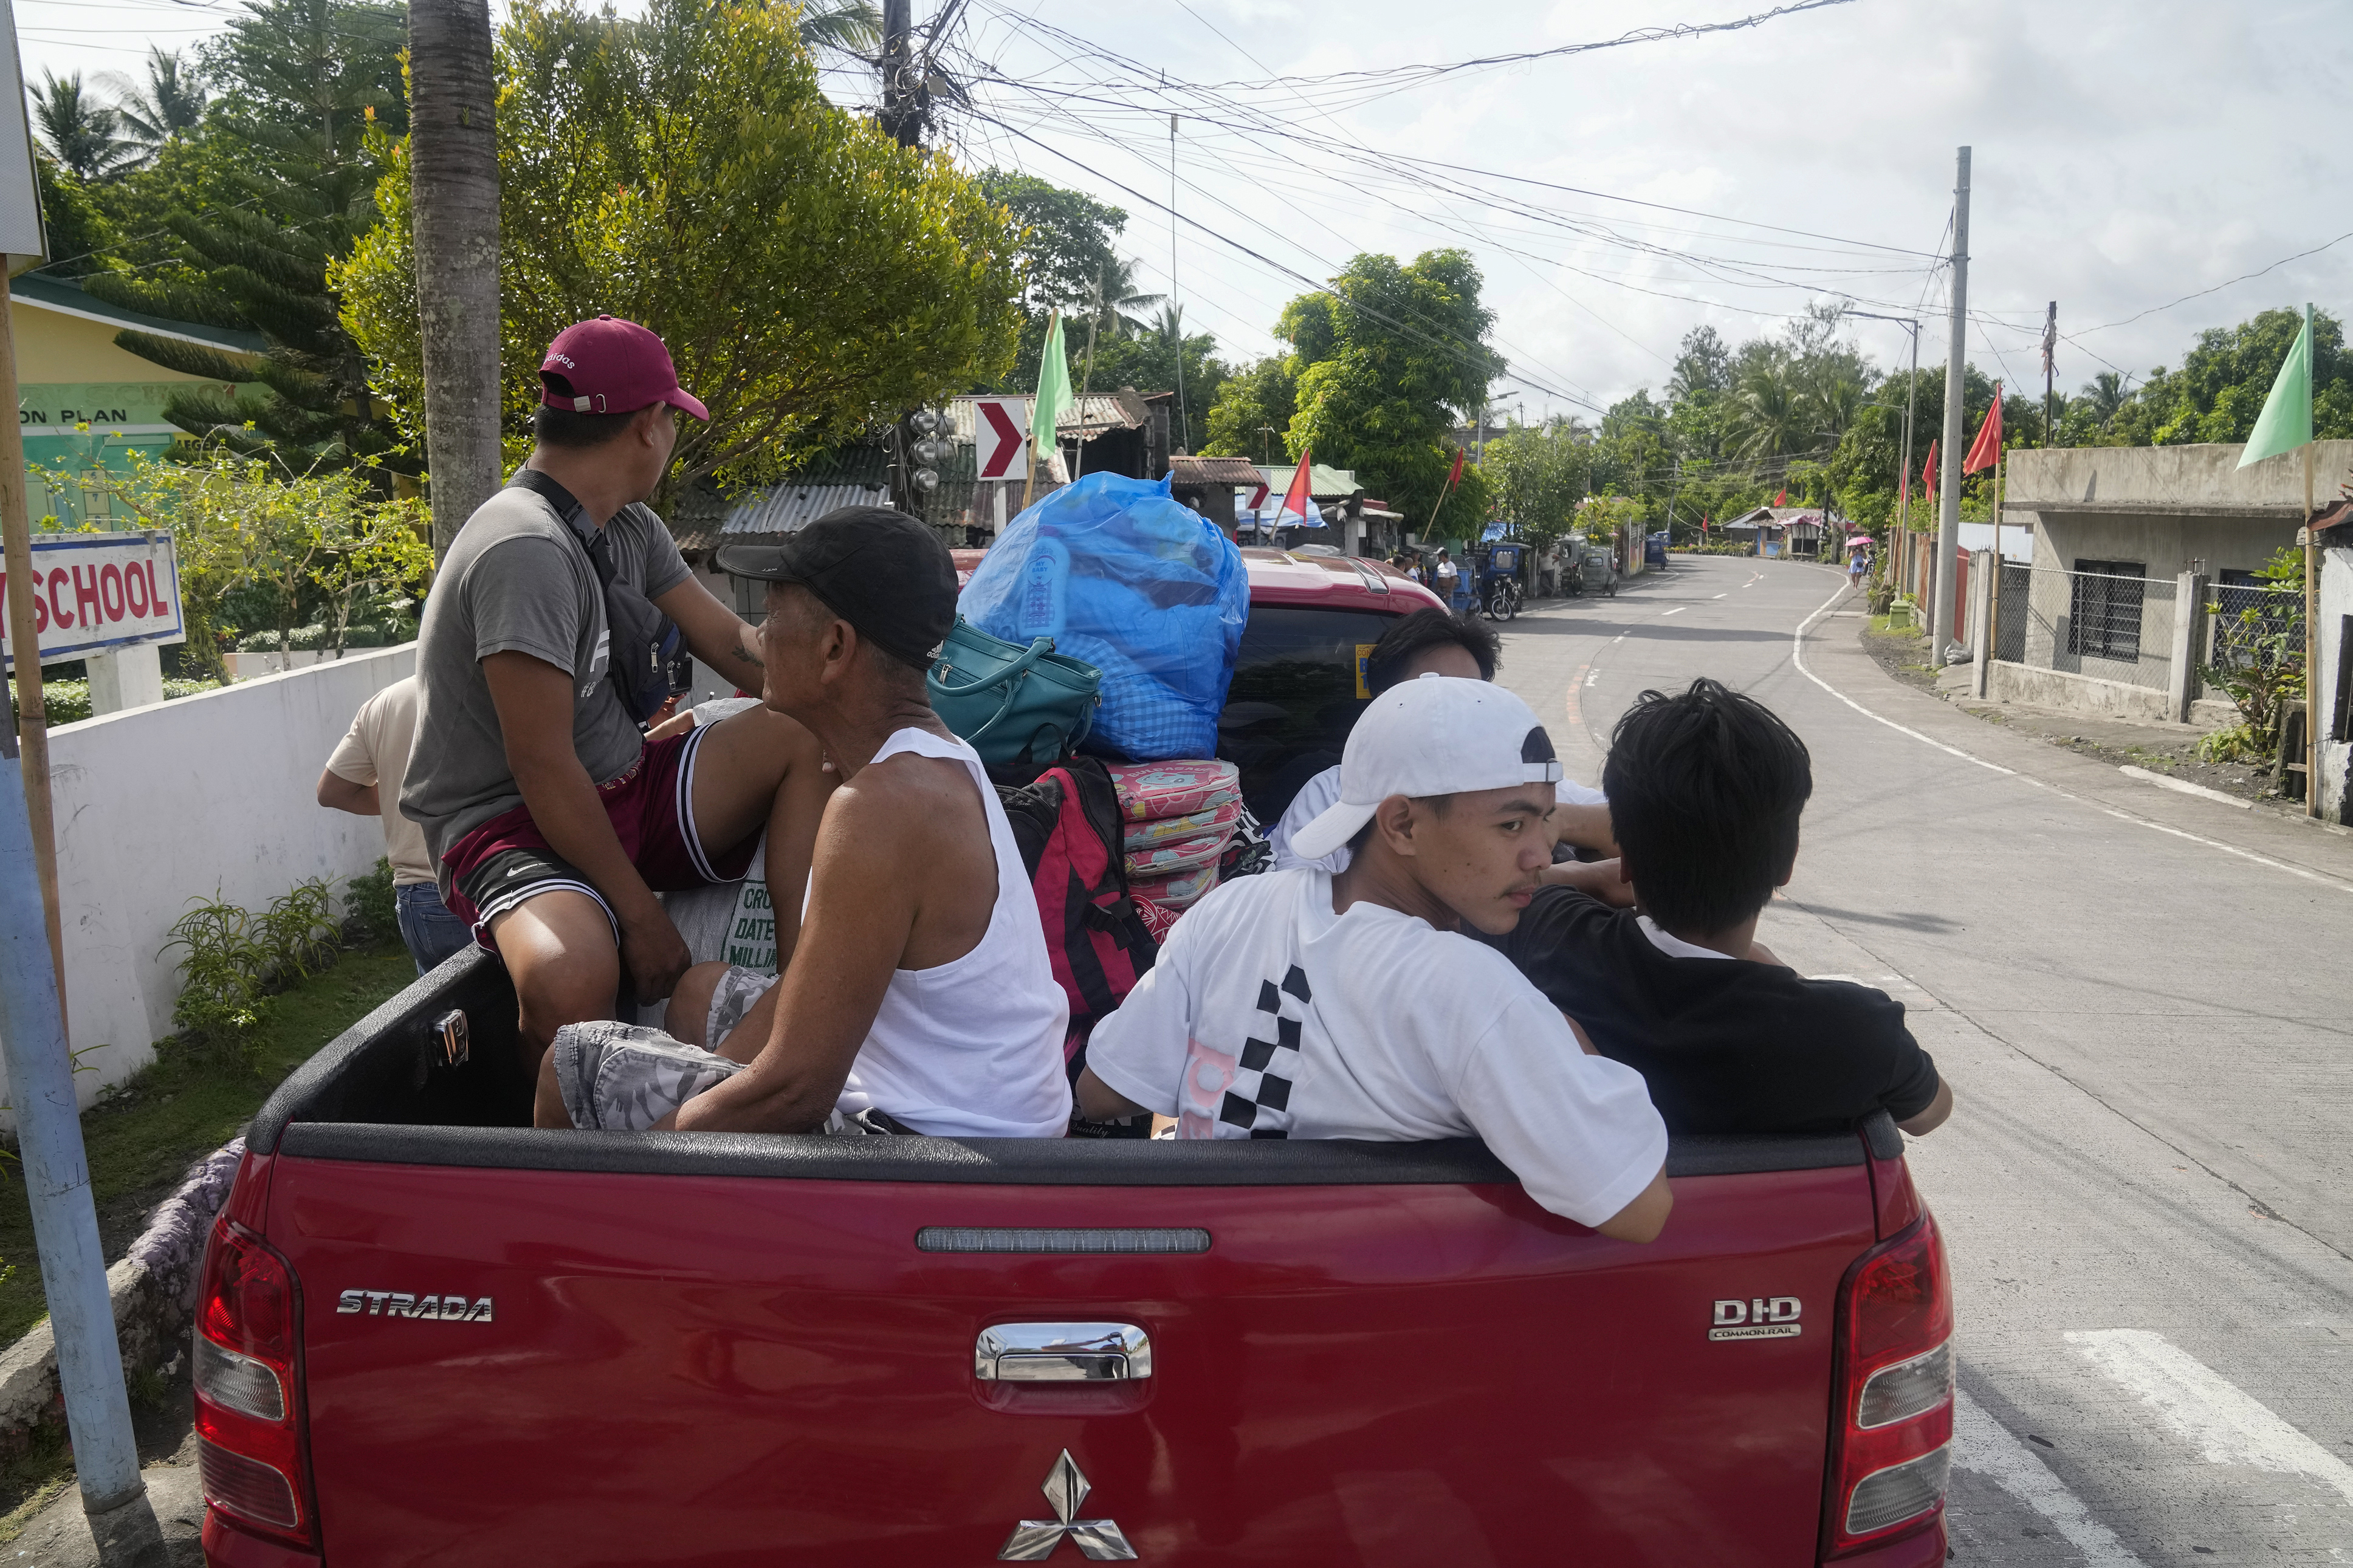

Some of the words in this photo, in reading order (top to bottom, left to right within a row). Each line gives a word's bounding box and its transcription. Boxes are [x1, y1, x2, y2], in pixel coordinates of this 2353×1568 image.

[61, 409, 127, 423] PLAN
[177, 439, 220, 451] LEGEN
[92, 493, 98, 502] 7
[32, 559, 169, 634] SCHOOL
[734, 917, 775, 941] DATE
[1070, 1121, 1111, 1138] Quality
[337, 1289, 493, 1322] STRADA
